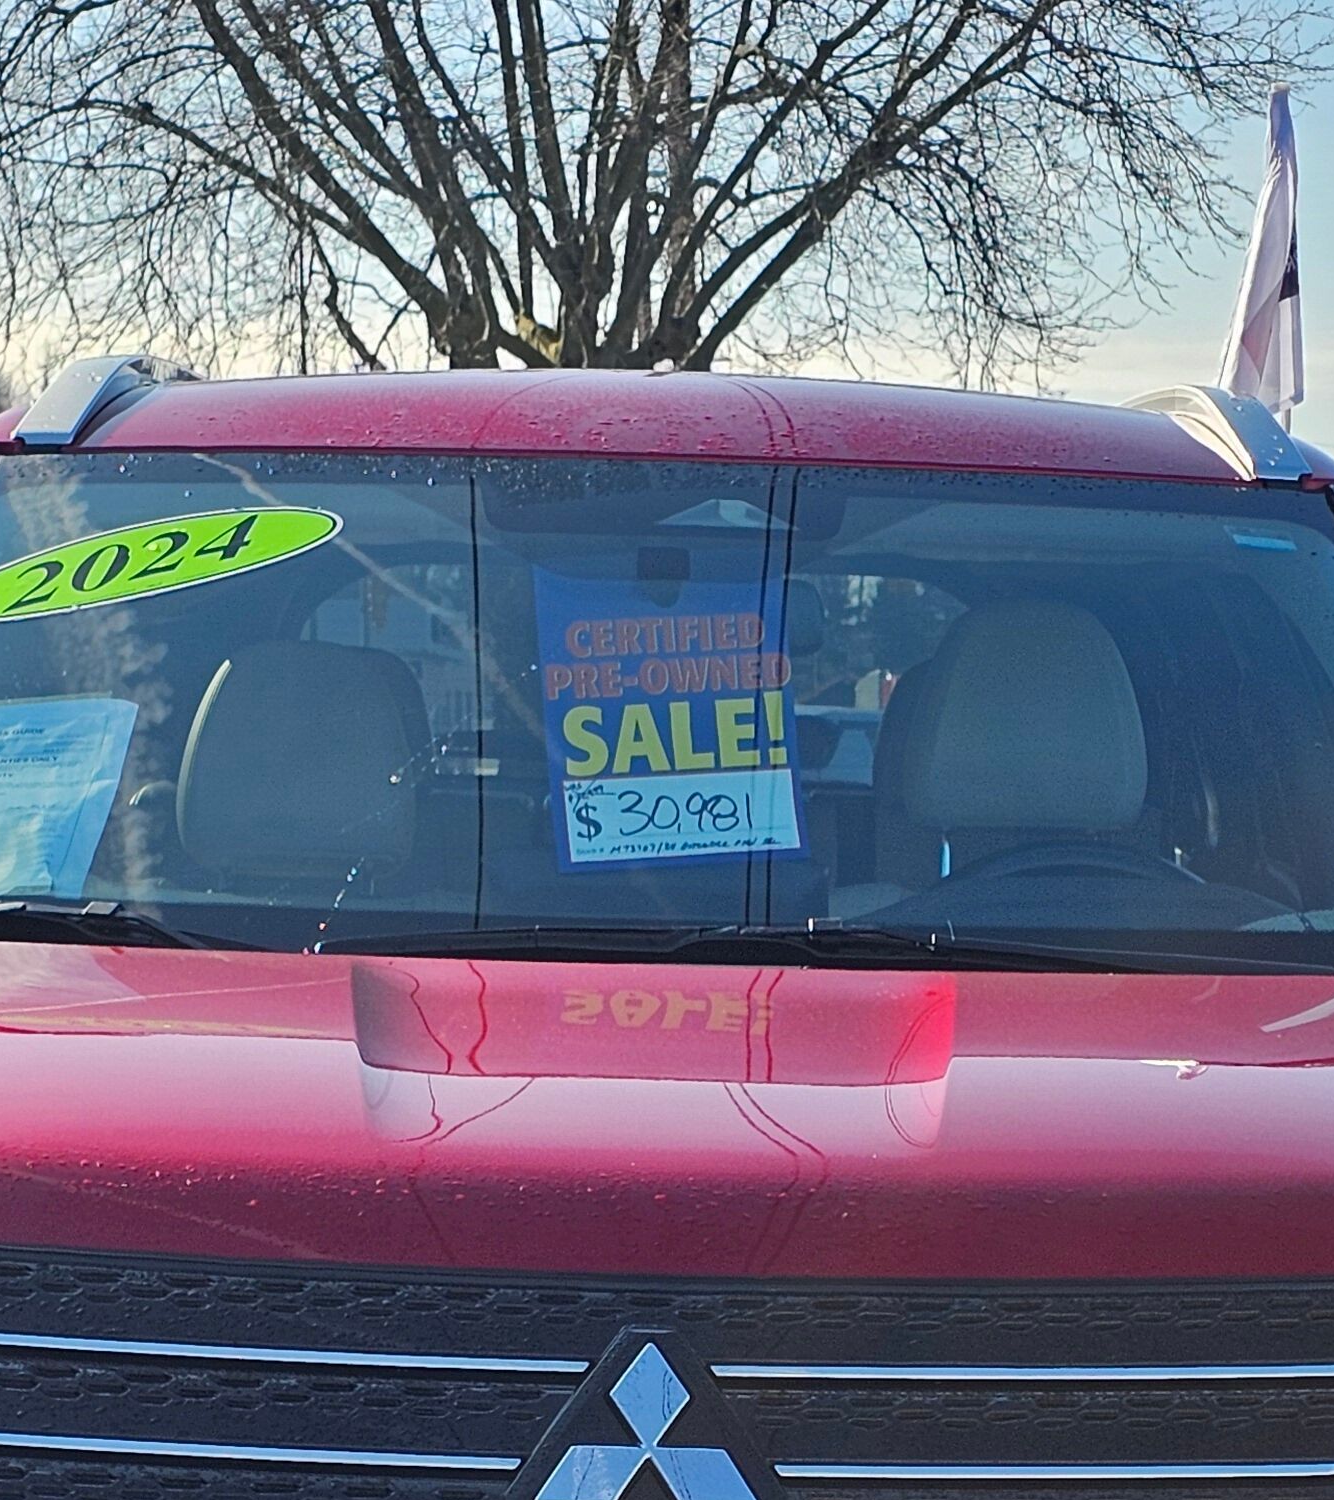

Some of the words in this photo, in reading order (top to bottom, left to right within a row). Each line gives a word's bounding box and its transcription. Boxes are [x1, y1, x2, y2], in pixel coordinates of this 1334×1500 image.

[2, 514, 259, 613] 2024
[566, 612, 765, 658] CERTIFIED
[546, 652, 792, 700] PRE-OWNED
[563, 690, 788, 778] SALE!
